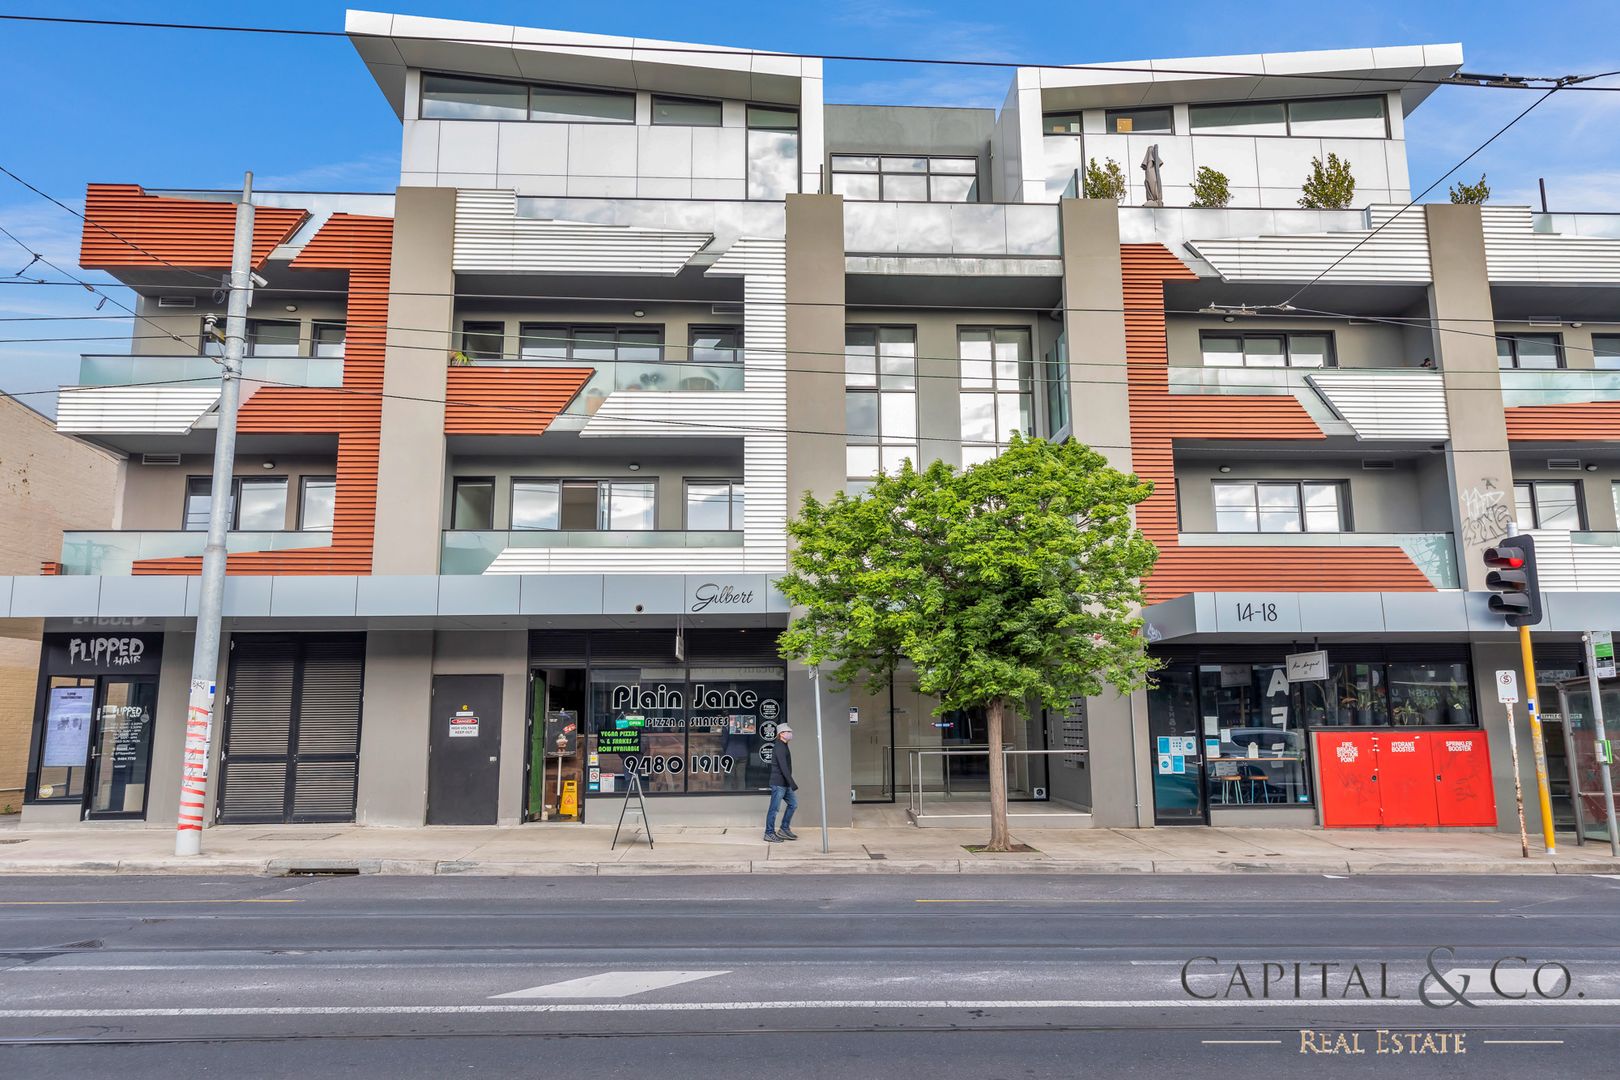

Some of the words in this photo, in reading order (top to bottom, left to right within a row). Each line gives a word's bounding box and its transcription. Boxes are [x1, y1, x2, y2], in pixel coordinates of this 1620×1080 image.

[691, 583, 754, 612] Gilbert
[1236, 603, 1278, 621] 14-18
[69, 638, 144, 667] FLIPPED
[113, 656, 141, 666] HAIR
[612, 684, 683, 709] Plain
[693, 684, 758, 709] Jane
[645, 718, 676, 727] PIZZA
[690, 716, 729, 727] SHAKES
[624, 755, 685, 775] 9480
[691, 755, 734, 773] 1919
